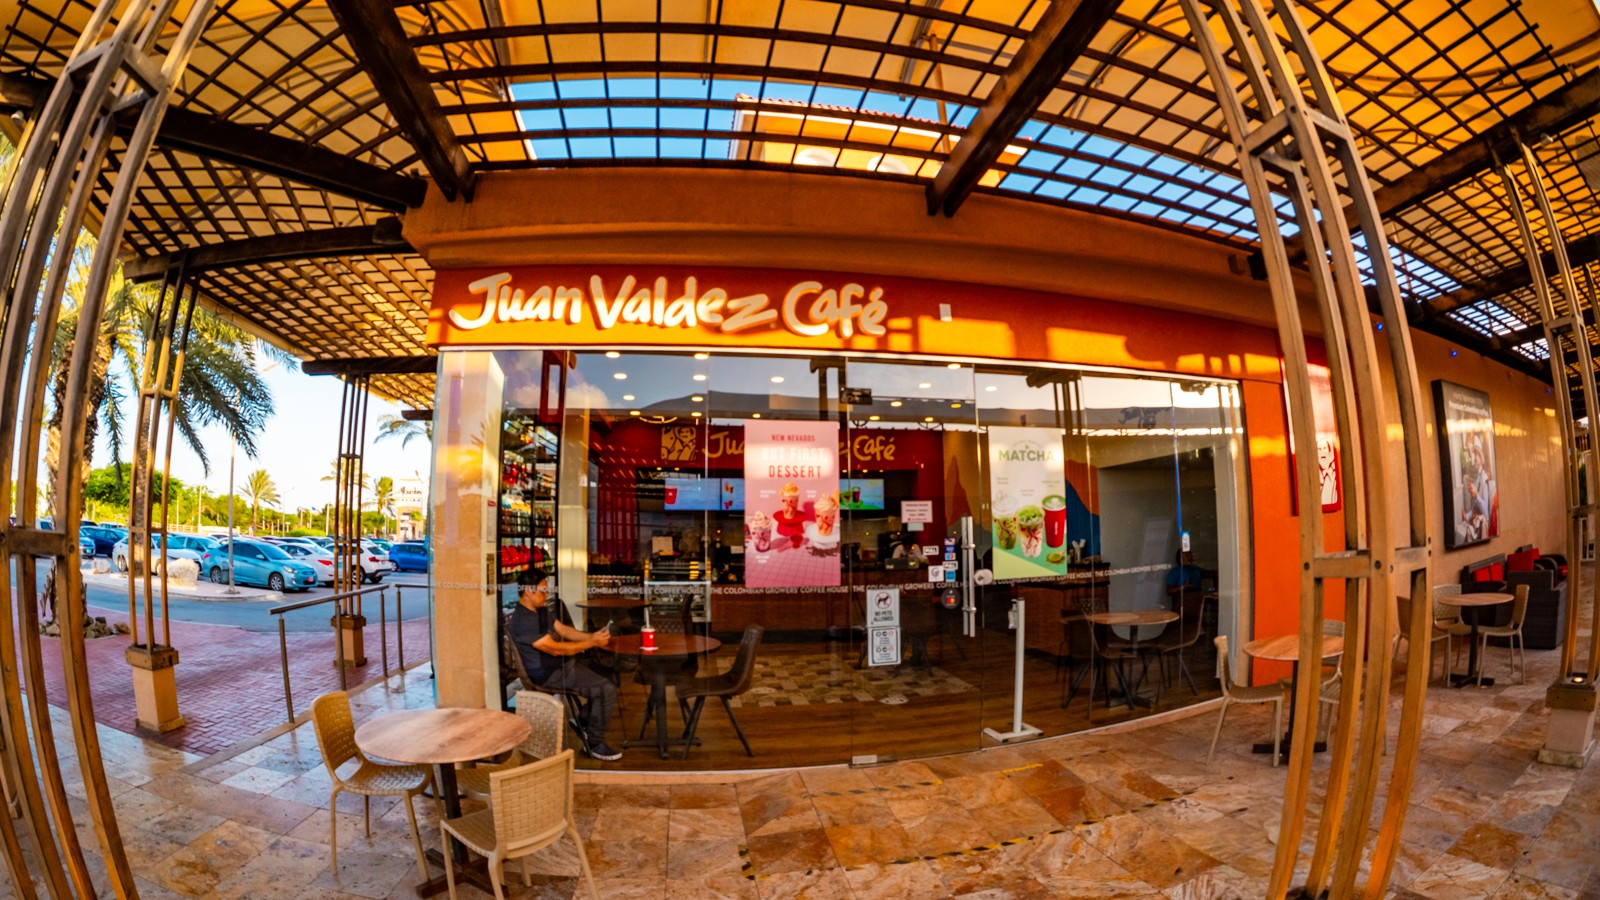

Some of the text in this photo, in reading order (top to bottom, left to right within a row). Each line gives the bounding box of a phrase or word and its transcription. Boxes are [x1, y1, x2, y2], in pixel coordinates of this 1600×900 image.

[448, 272, 888, 338] Juan Valdez Café
[771, 434, 785, 442] NEW
[761, 447, 785, 461] BUT
[853, 435, 896, 461] Café
[998, 449, 1055, 462] MATCHA
[768, 465, 822, 479] DESSERT
[800, 586, 825, 594] COFFEE
[852, 584, 865, 593] THE
